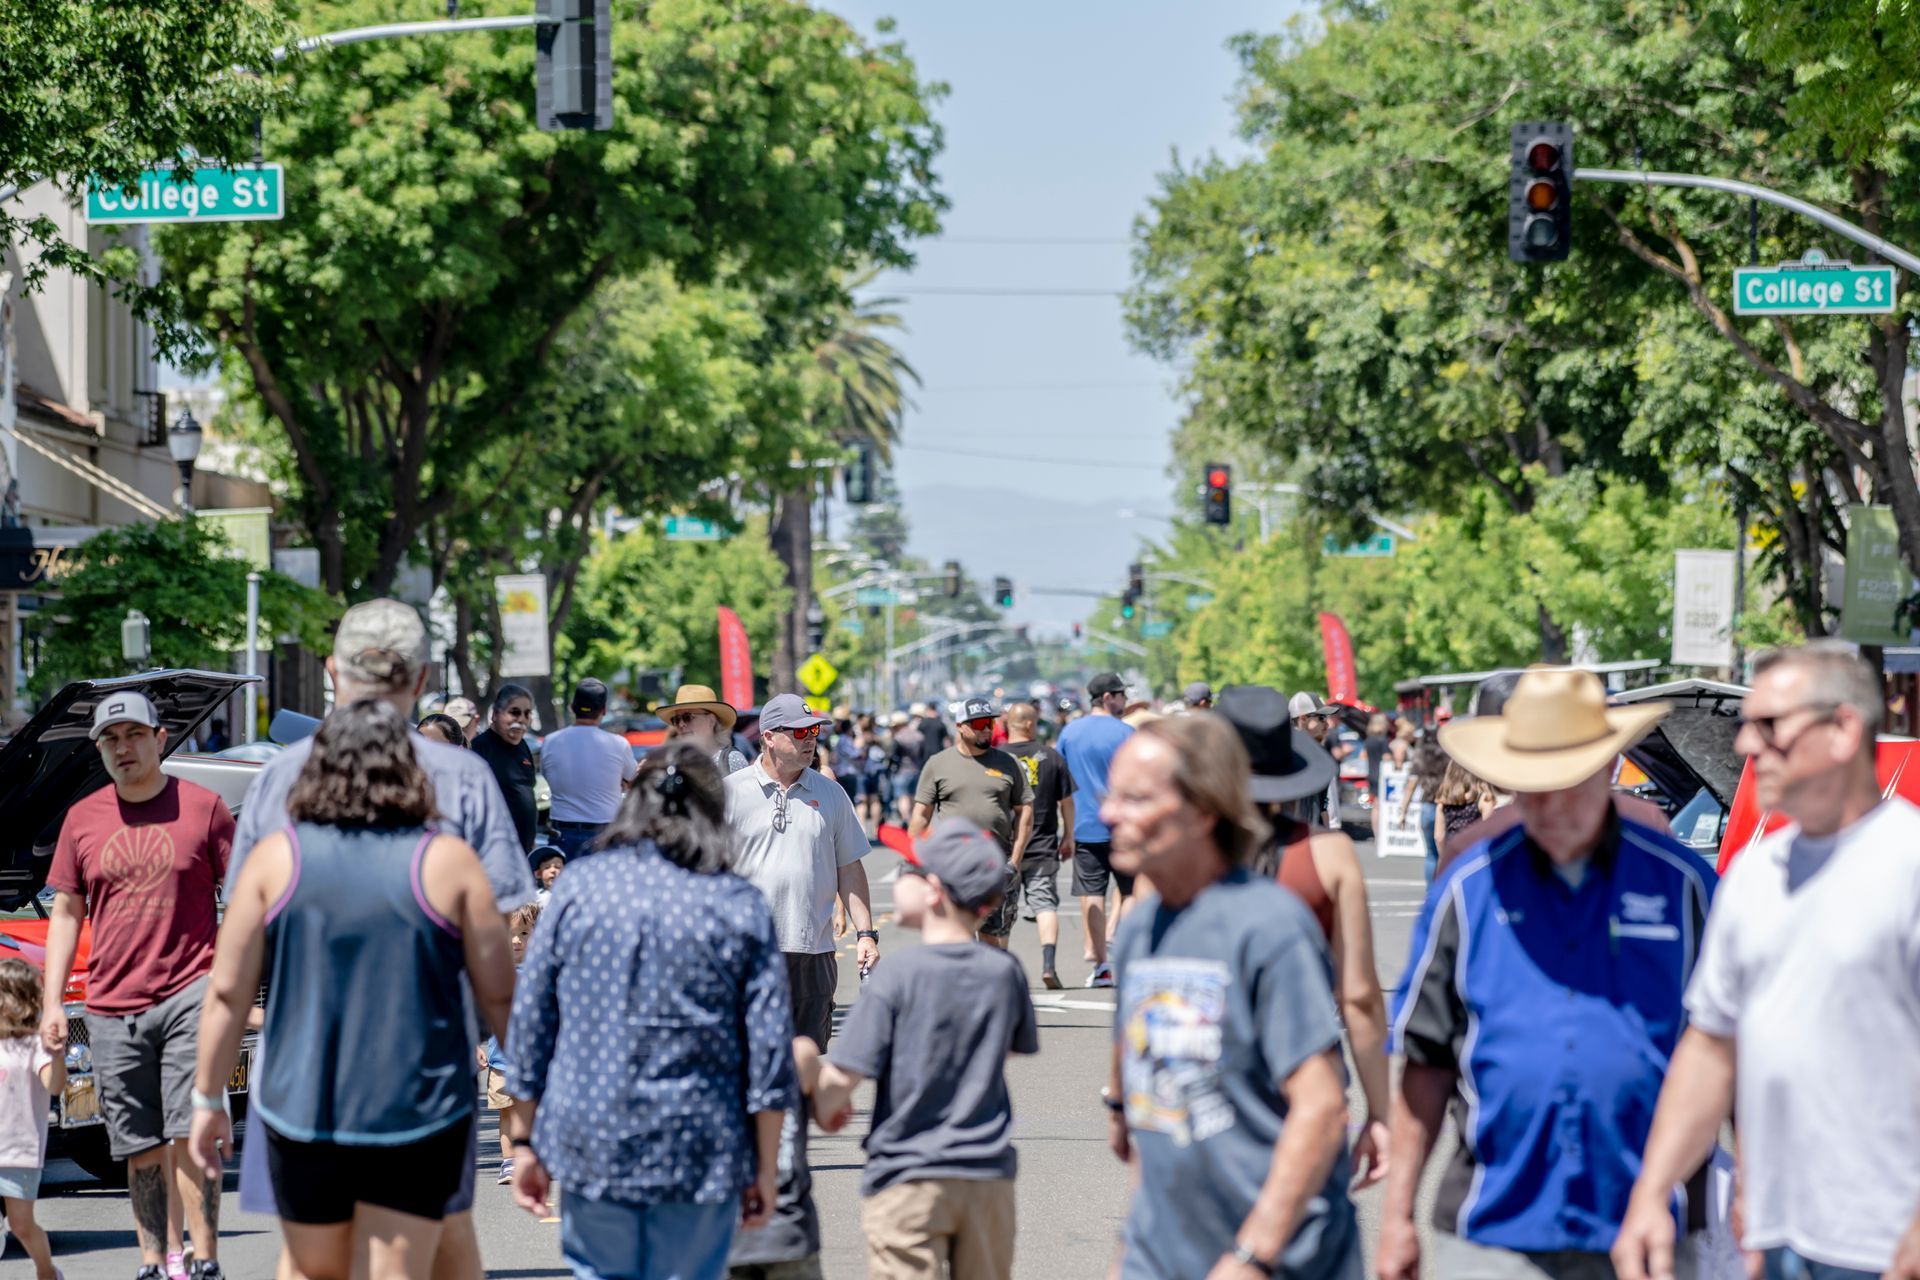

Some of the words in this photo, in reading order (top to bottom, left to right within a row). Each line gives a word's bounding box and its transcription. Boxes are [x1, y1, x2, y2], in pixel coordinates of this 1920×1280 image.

[98, 180, 220, 218] College
[232, 176, 269, 208] St
[1745, 277, 1844, 310] College
[1854, 275, 1884, 303] St
